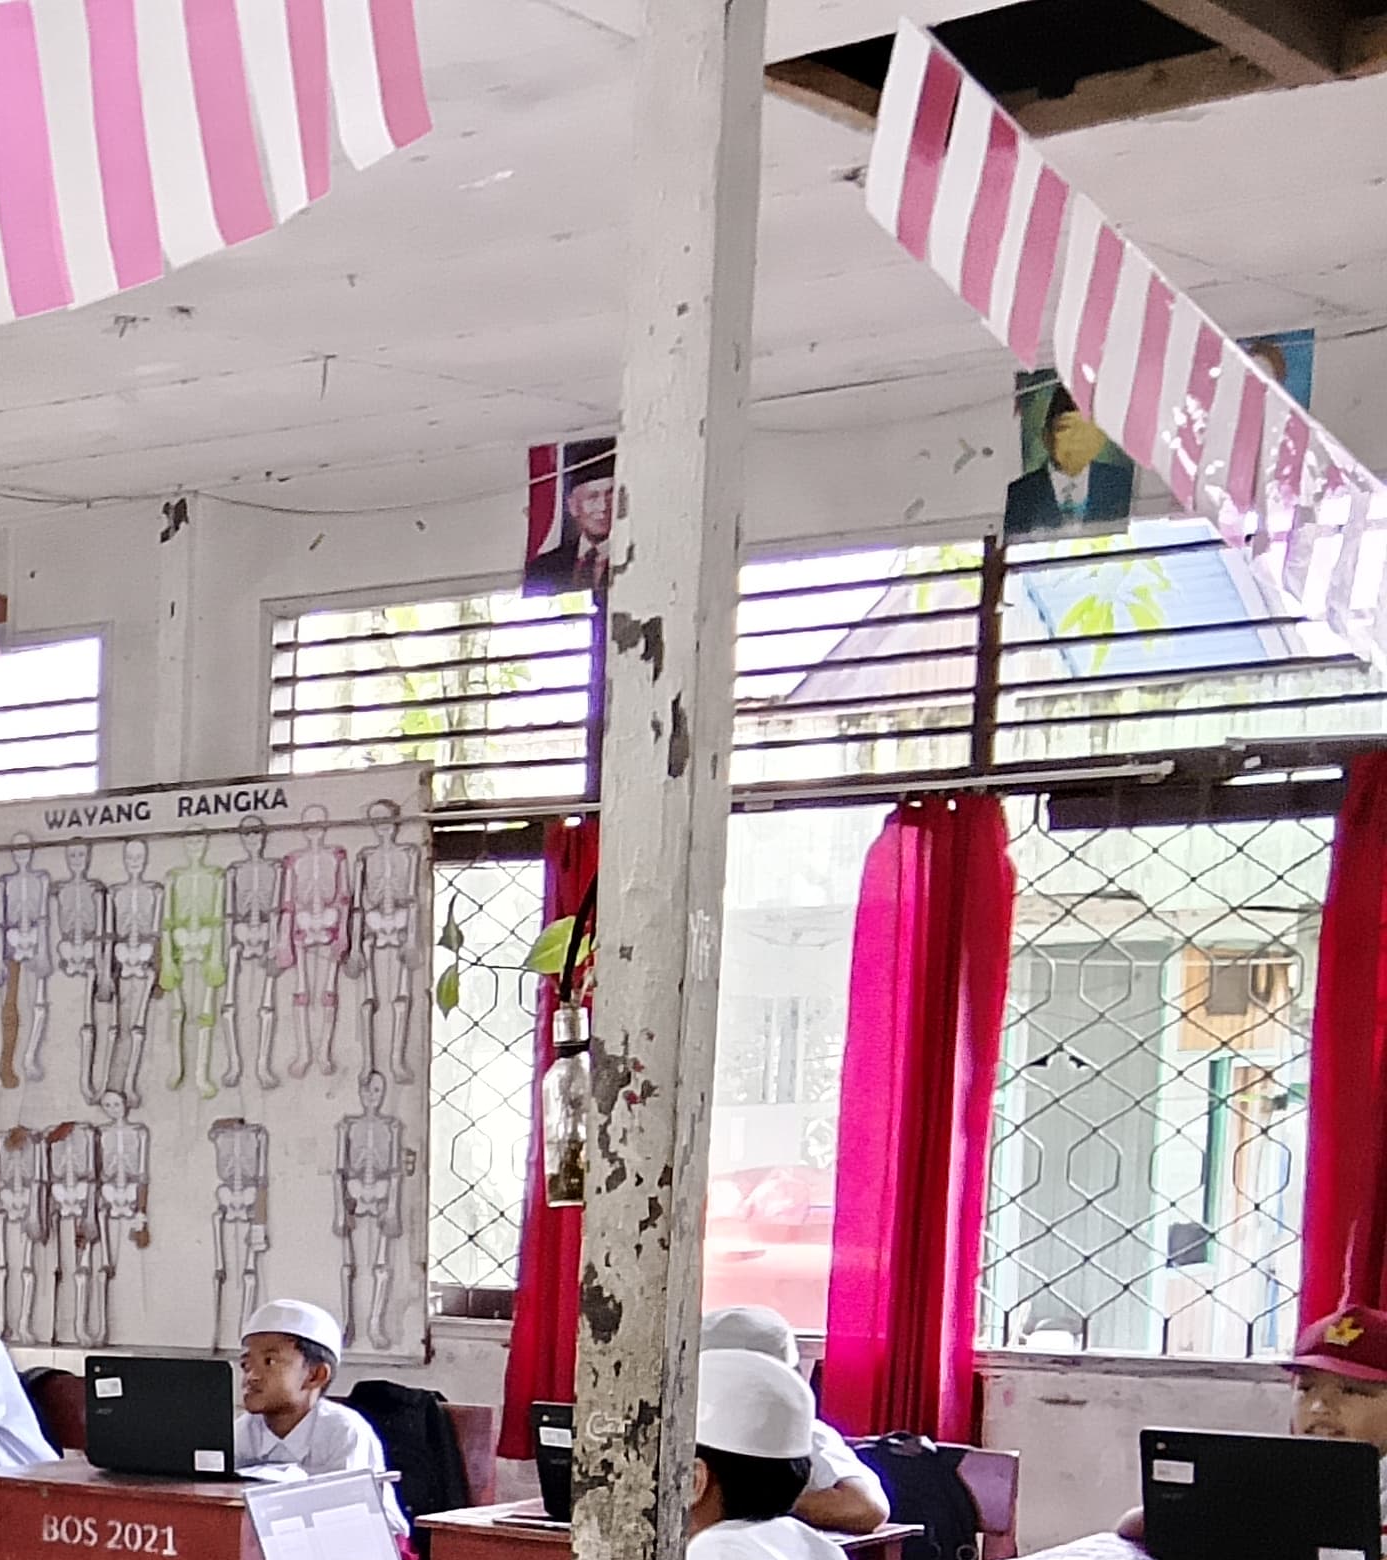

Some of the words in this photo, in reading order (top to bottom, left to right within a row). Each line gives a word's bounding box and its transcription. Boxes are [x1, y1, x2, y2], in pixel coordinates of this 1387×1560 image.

[44, 800, 151, 831] WAYANG
[177, 787, 289, 818] RANGKA
[41, 1514, 98, 1547] BOS
[106, 1520, 178, 1557] 2021
